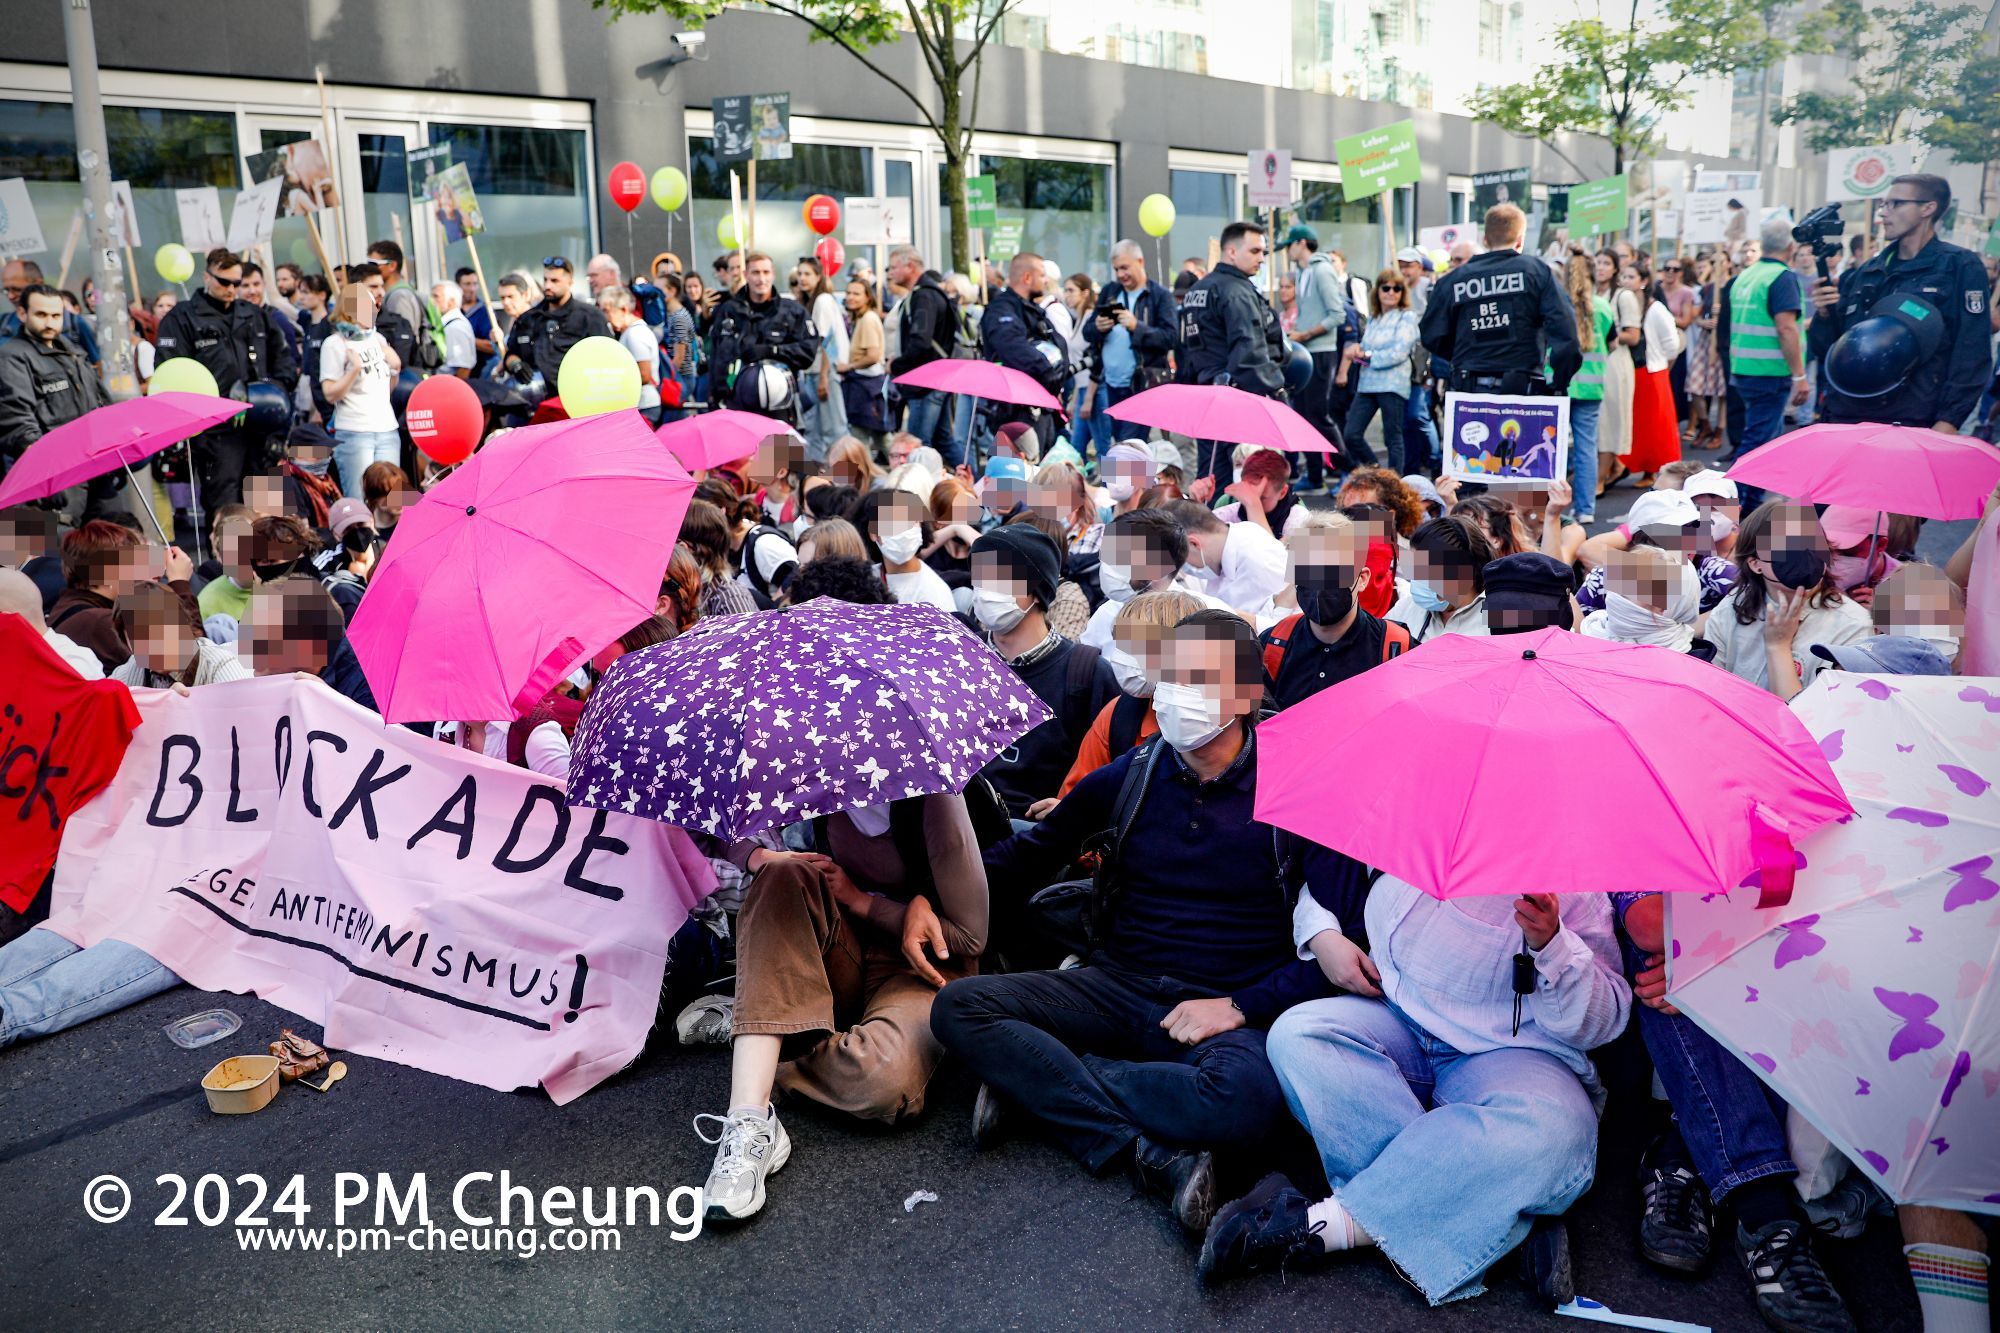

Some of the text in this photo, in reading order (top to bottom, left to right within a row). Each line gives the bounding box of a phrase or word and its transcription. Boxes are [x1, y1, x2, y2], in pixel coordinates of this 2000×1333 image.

[1361, 135, 1389, 148] Leben
[1453, 272, 1525, 302] POLIZEI
[1480, 302, 1498, 316] BE
[1471, 313, 1510, 331] 31214
[146, 715, 630, 902] BLOCKADE
